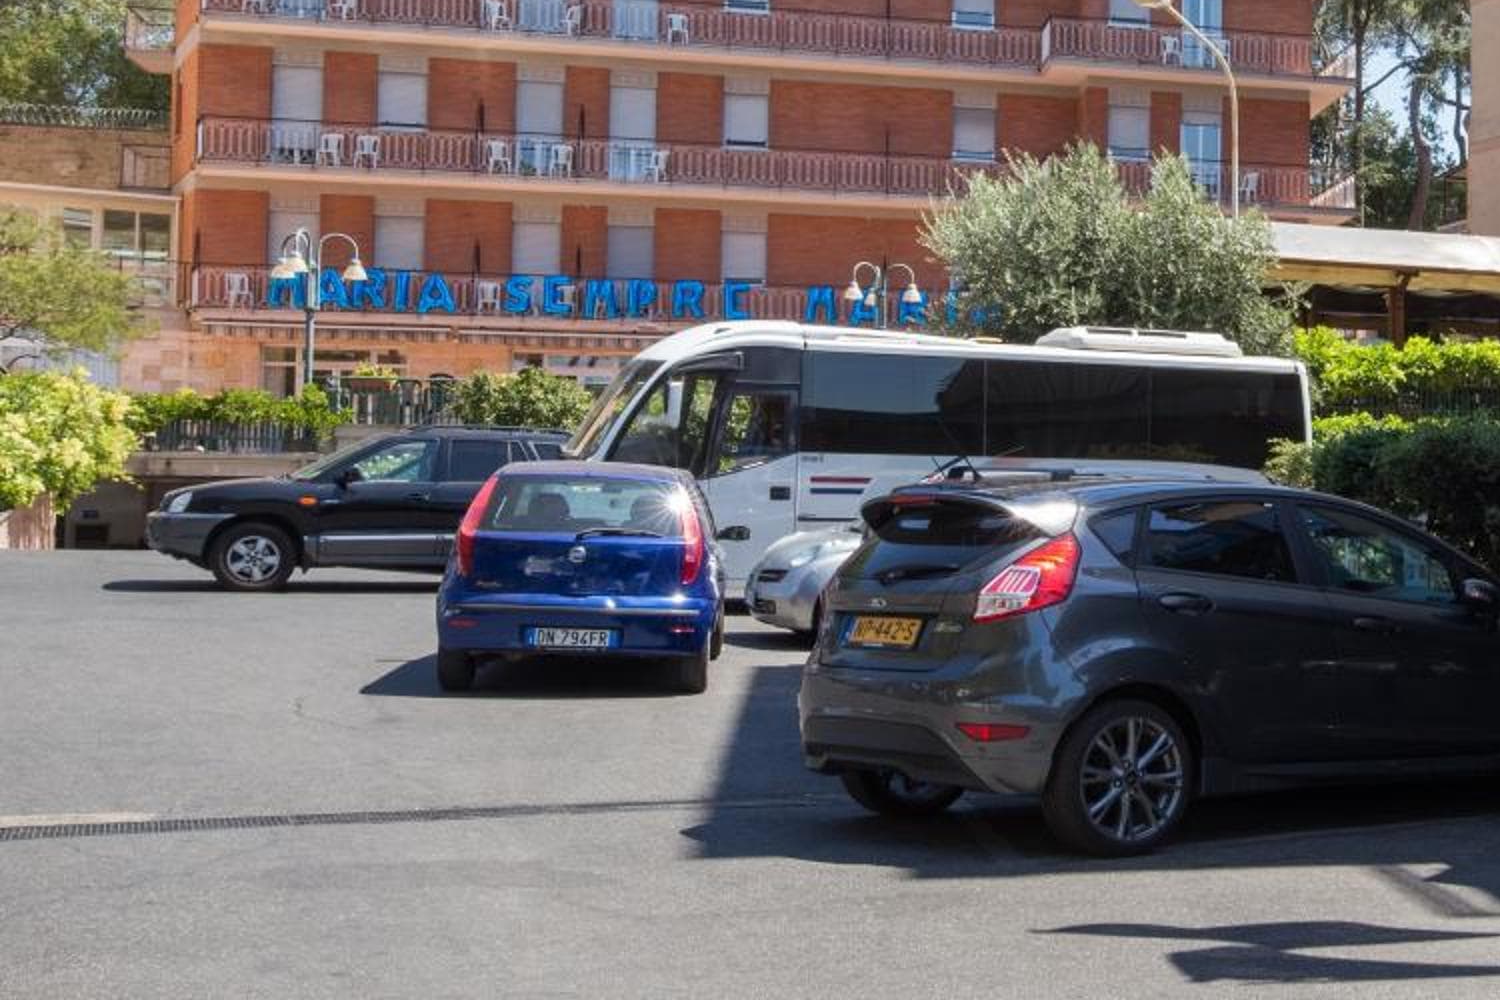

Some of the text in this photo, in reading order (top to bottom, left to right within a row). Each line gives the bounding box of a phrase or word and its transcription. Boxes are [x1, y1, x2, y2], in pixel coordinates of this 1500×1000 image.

[267, 265, 1000, 330] MARIA SEMPRE MARI
